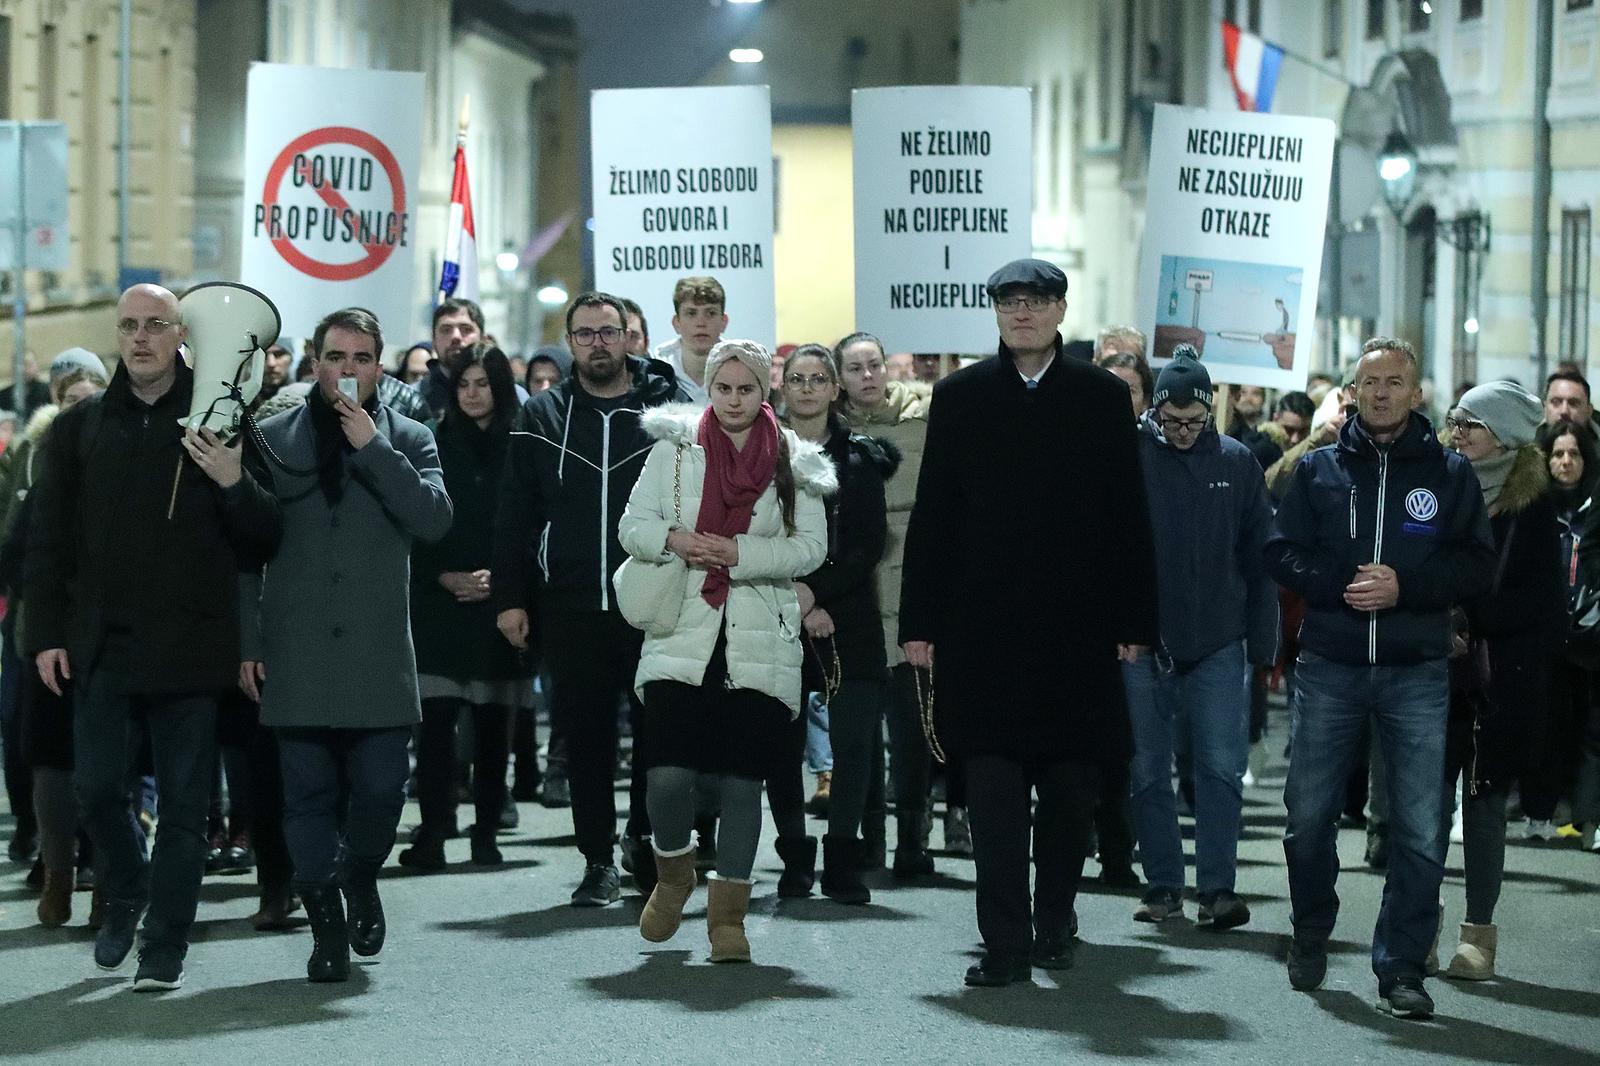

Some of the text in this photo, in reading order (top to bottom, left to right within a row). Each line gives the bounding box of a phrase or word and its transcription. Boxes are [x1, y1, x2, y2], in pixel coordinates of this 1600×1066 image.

[901, 125, 991, 156] NE ŽELIMO
[1186, 128, 1303, 163] NECIJEPLJENI
[292, 153, 374, 191] COVID
[610, 165, 758, 195] ŽELIMO SLOBODU
[910, 169, 983, 195] PODJELE
[1178, 166, 1303, 202] NE ZASLUŽUJU
[254, 203, 409, 247] PROPUSNICE
[643, 206, 729, 232] GOVORA I
[884, 207, 1008, 233] NA CIJEPLJENE
[1201, 207, 1271, 239] OTKAZE
[612, 243, 764, 272] SLOBODU IZBORA
[944, 245, 951, 270] I
